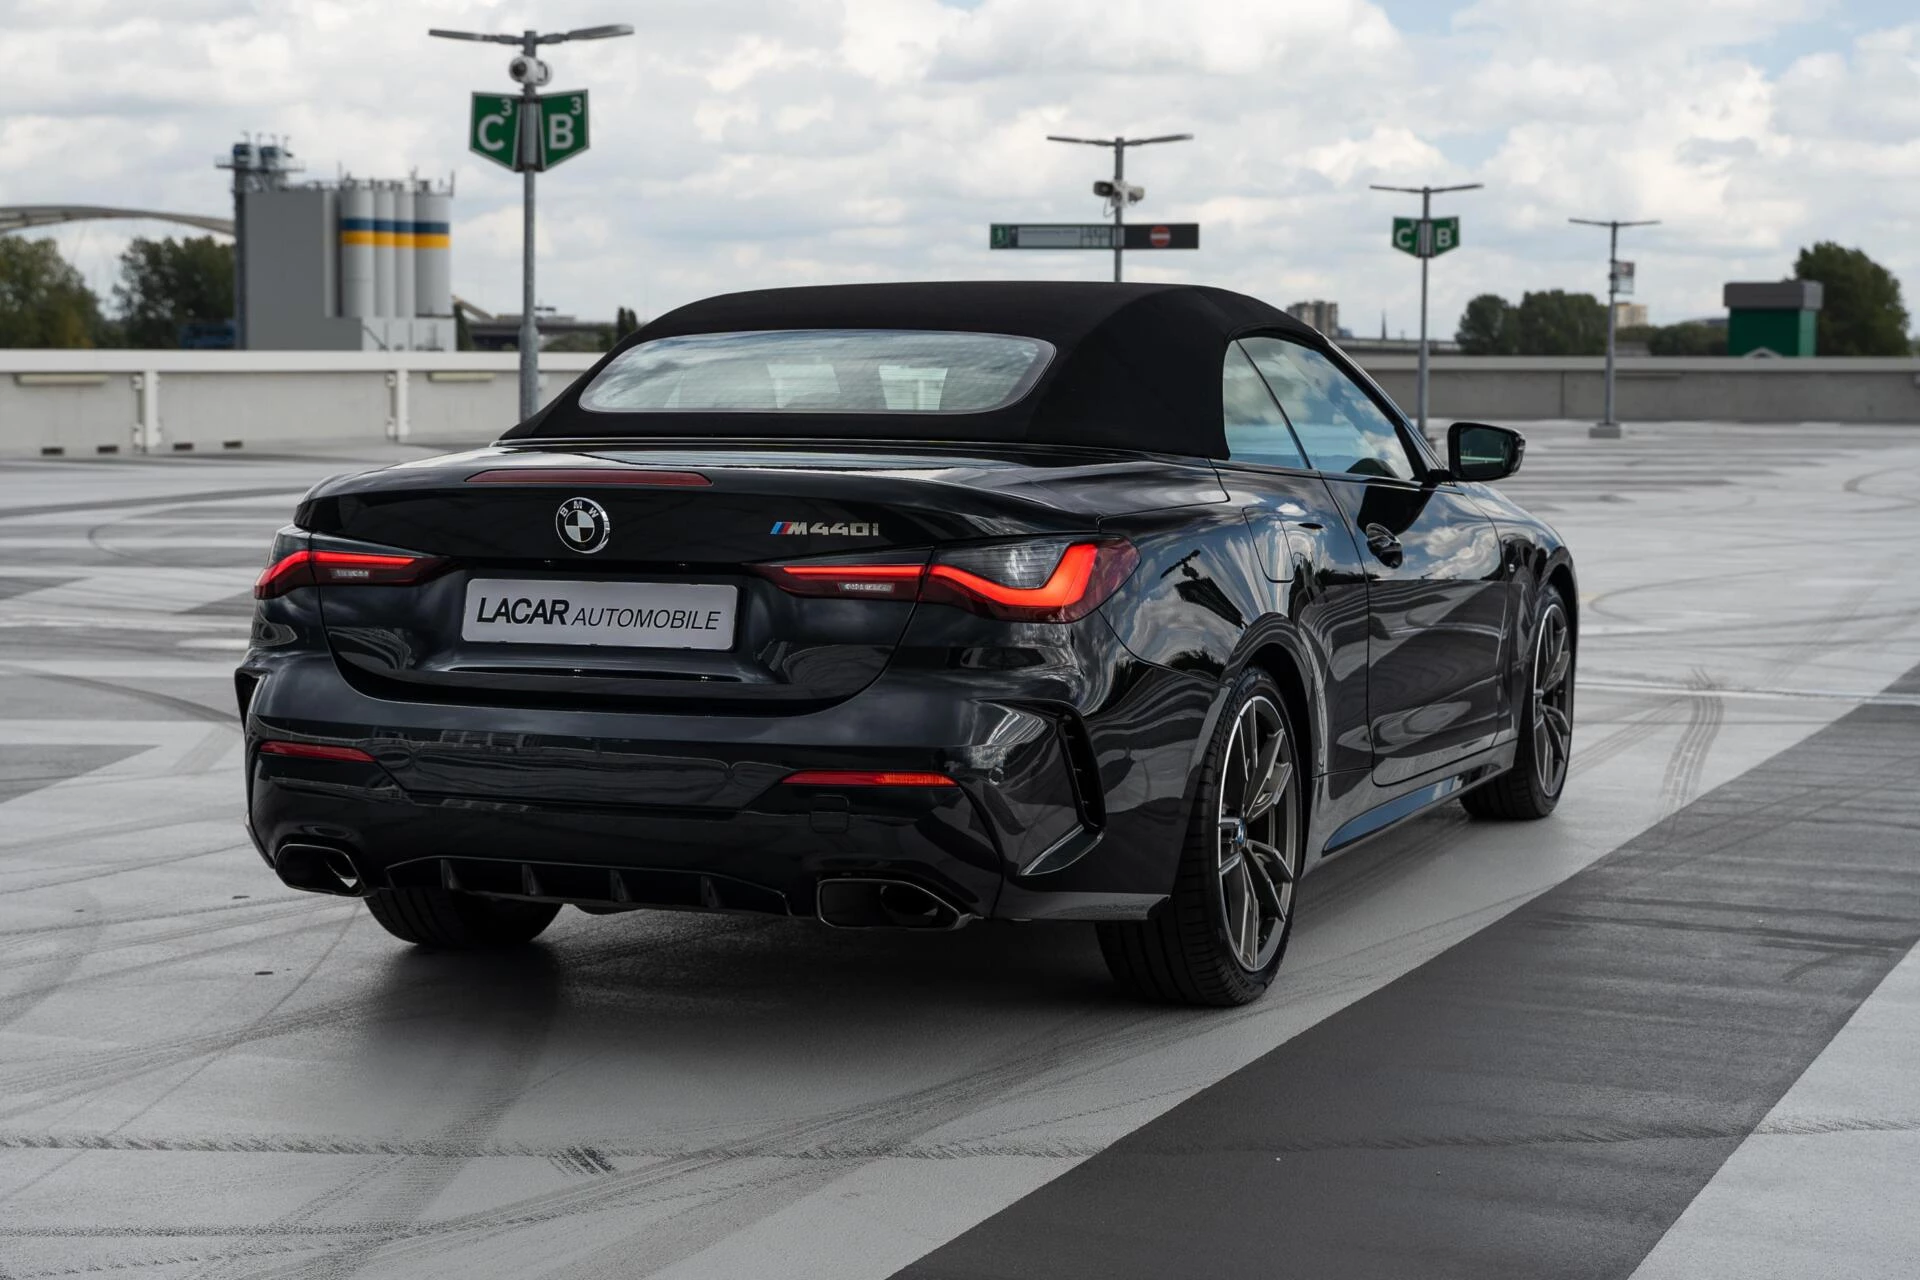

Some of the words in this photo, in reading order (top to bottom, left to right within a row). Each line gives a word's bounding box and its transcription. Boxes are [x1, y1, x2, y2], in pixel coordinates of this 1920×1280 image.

[501, 98, 513, 117] 3
[570, 96, 582, 115] 3
[478, 114, 505, 151] C
[549, 113, 574, 150] B
[1396, 227, 1413, 248] C
[1436, 227, 1452, 248] B
[560, 500, 599, 518] BMW
[786, 521, 879, 536] M440i
[476, 597, 570, 626] LACAR
[570, 607, 722, 630] AUTOMOBILE
